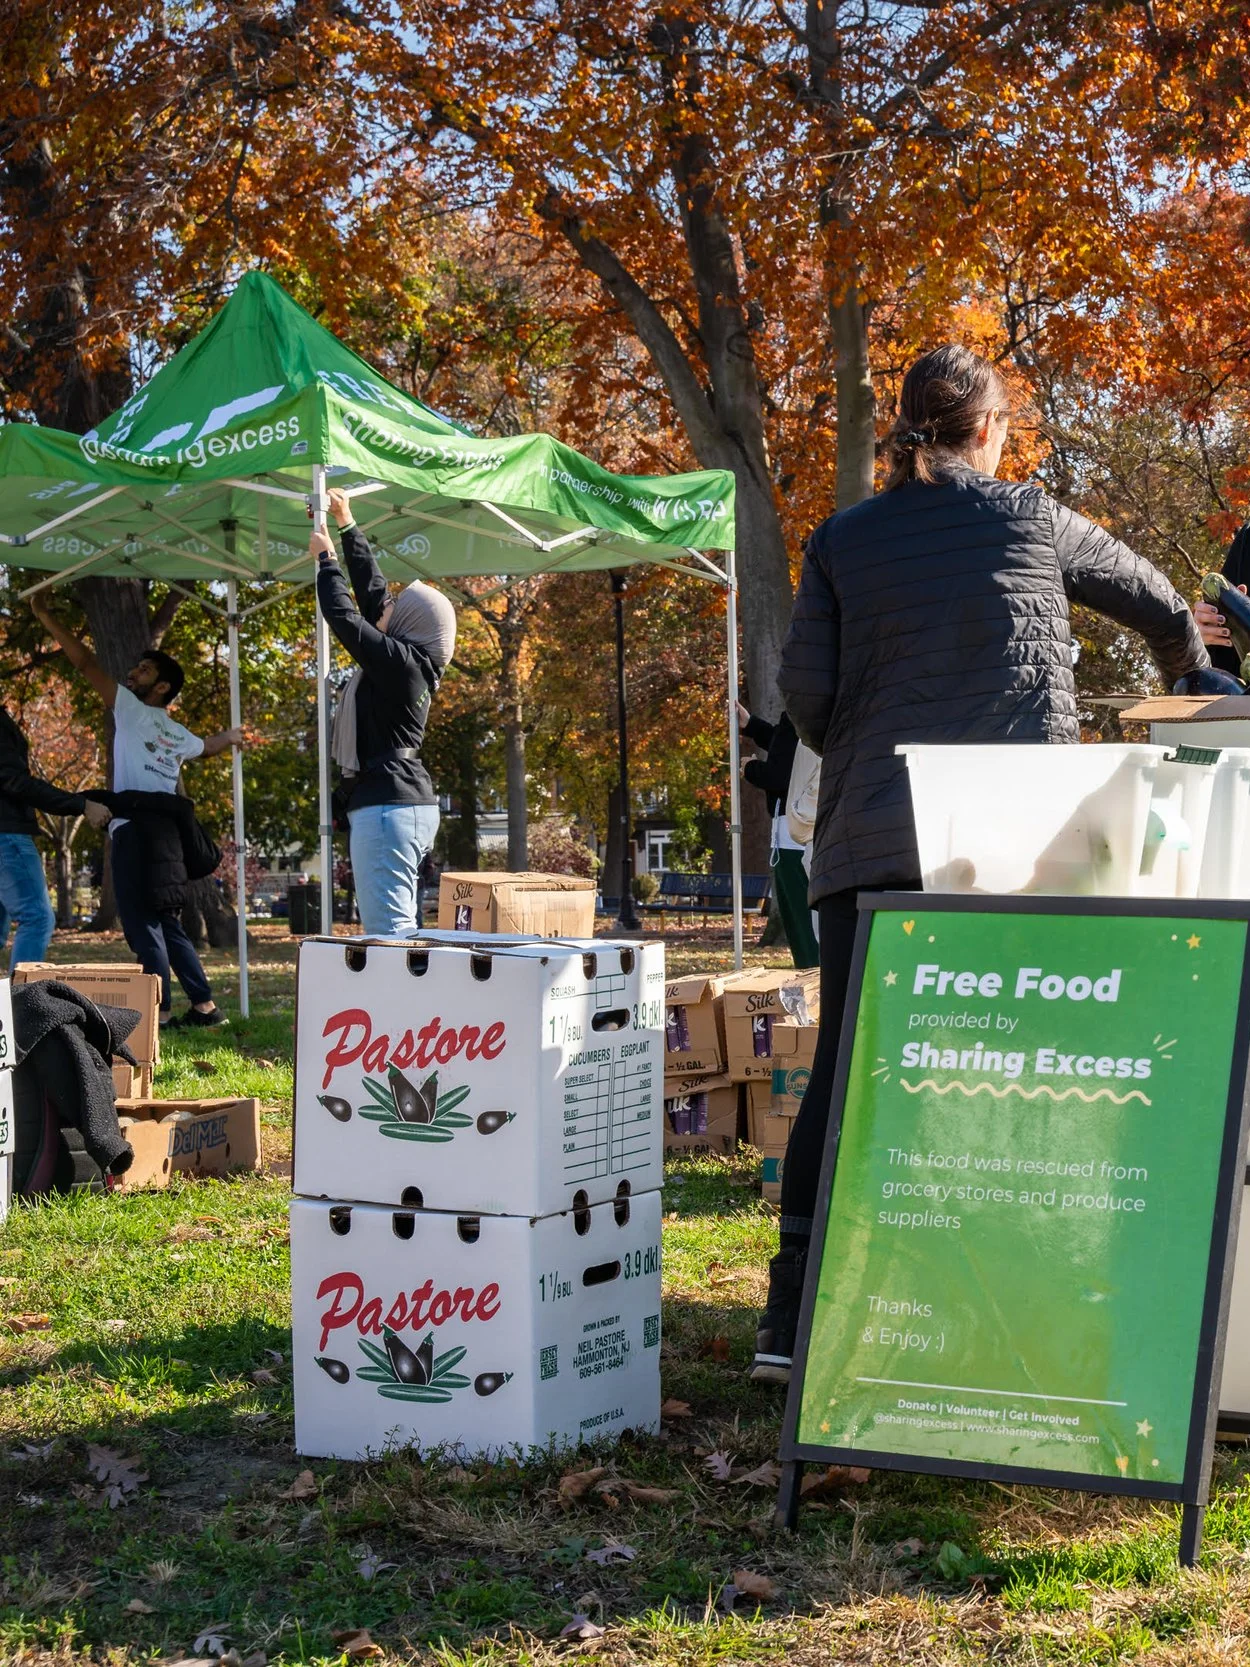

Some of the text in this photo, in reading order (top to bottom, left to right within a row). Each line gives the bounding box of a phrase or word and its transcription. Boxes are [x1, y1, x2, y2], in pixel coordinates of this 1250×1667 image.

[343, 411, 506, 470] Sharing Excess
[452, 882, 474, 900] Silk
[912, 964, 1122, 1002] Free Food
[746, 994, 775, 1012] Silk
[550, 1016, 556, 1044] 1
[572, 1026, 583, 1041] BU.
[633, 1002, 646, 1031] 3.9
[908, 1012, 1019, 1034] provided by
[322, 1008, 506, 1090] Pastore
[569, 1041, 650, 1066] CUCUMBERS EGGPLANT
[900, 1041, 1152, 1080] Sharing Excess
[686, 1061, 706, 1070] GAL.
[745, 1067, 751, 1076] 6
[565, 1076, 578, 1086] SUPER
[579, 1073, 594, 1083] SELECT
[679, 1075, 709, 1092] Silk
[564, 1093, 578, 1102] SMALL
[564, 1109, 579, 1119] SELECT
[563, 1125, 576, 1136] LARGE
[563, 1142, 575, 1152] PLAIN
[888, 1148, 1148, 1182] This food was rescued from
[882, 1181, 1146, 1212] grocery stores and produce
[878, 1210, 961, 1230] suppliers
[539, 1274, 545, 1302] 1
[562, 1281, 573, 1298] BU.
[624, 1250, 641, 1280] 3.9
[644, 1245, 661, 1275] dkl.
[316, 1272, 501, 1352] Pastore
[867, 1295, 932, 1318] Thanks
[578, 1329, 625, 1355] NEIL PASTORE
[862, 1326, 873, 1343] &
[880, 1328, 932, 1352] Enjoy
[573, 1341, 630, 1369] HAMMONTON, NJ
[580, 1356, 624, 1379] 609-561-8464
[580, 1414, 602, 1430] PRODUCE
[603, 1412, 610, 1422] OF
[898, 1399, 937, 1412] Donate
[946, 1404, 1001, 1418] Volunteer
[1009, 1410, 1028, 1421] Get
[1032, 1412, 1080, 1426] Involved
[874, 1412, 958, 1430] @sharingexcess
[967, 1424, 1100, 1444] www.sharingexcess.com
